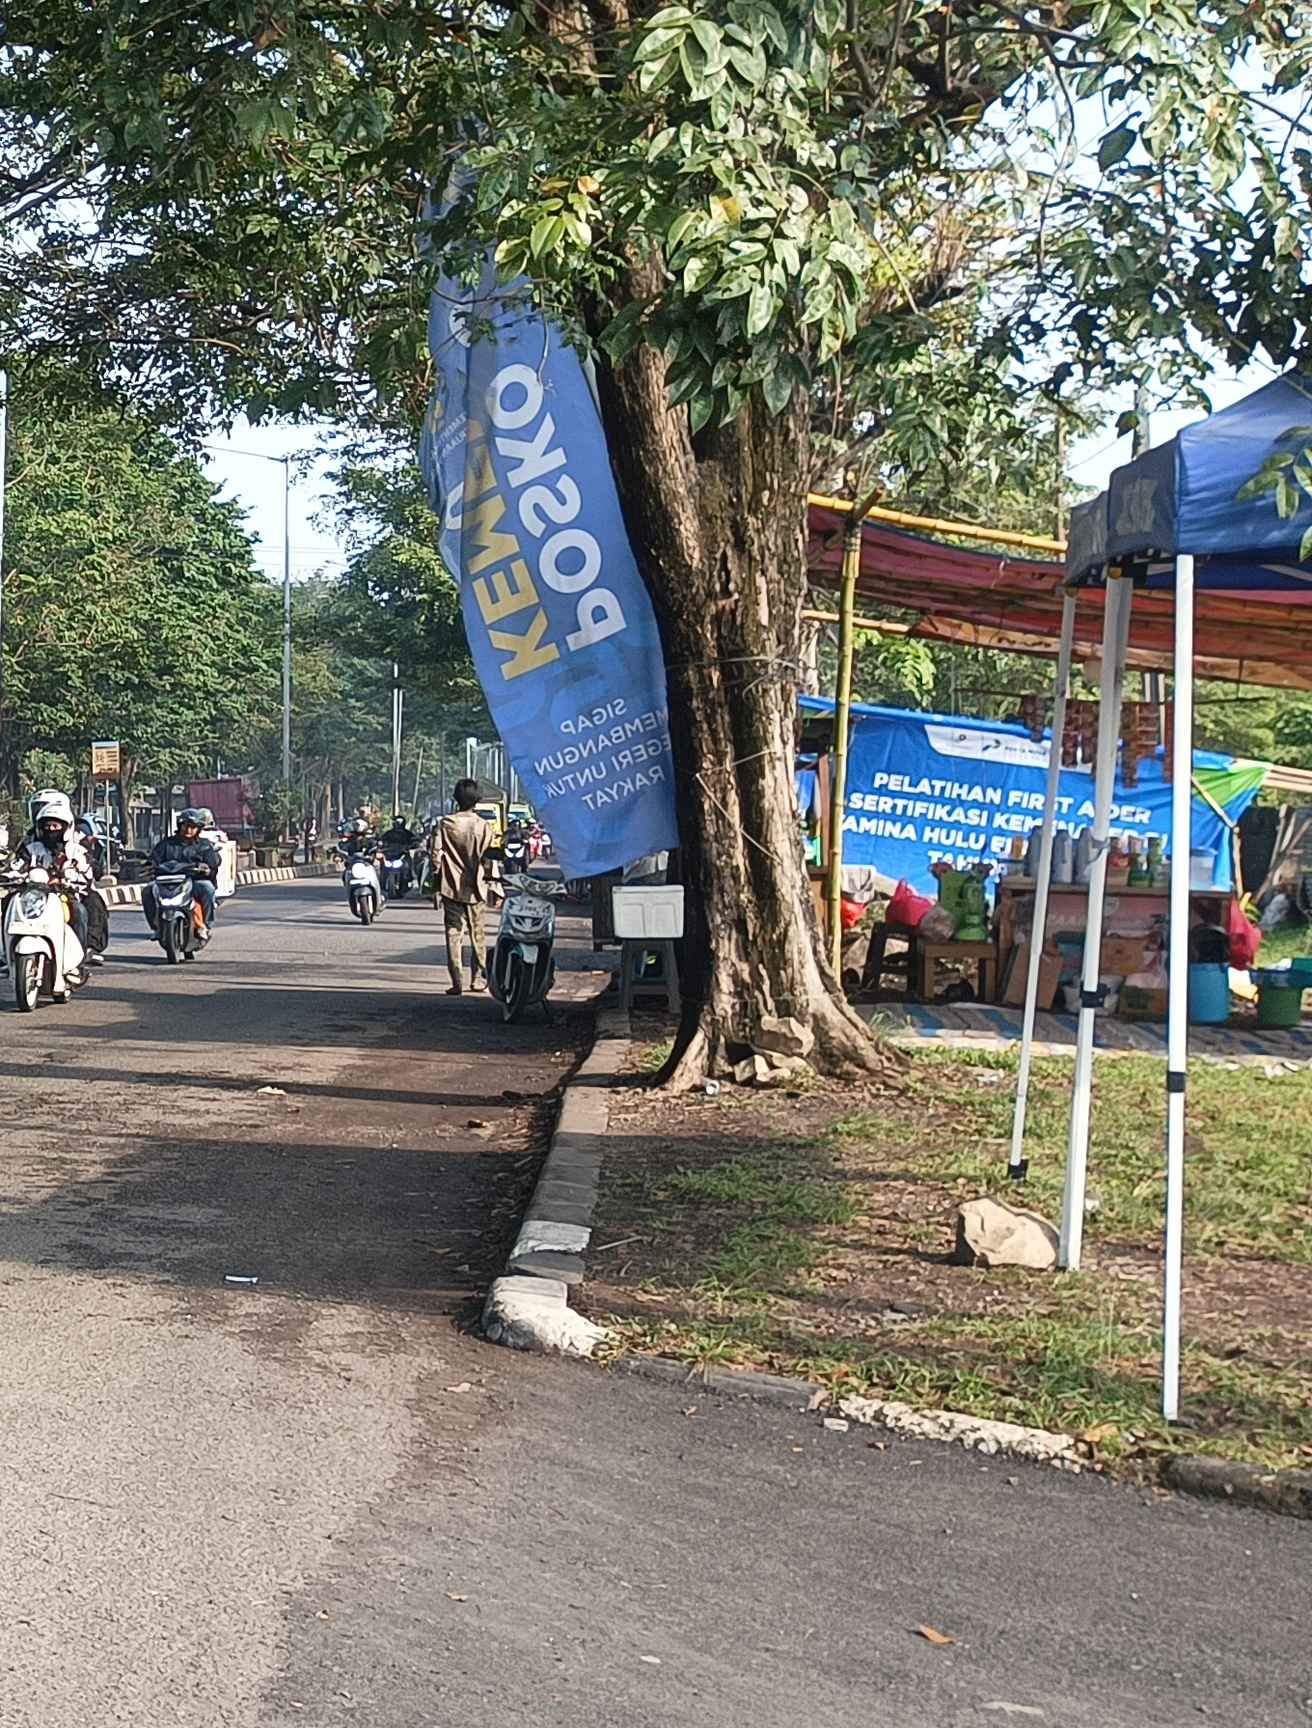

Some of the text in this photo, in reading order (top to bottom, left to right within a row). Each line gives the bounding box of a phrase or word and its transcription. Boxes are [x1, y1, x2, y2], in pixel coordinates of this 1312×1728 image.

[849, 793, 988, 827] SERTIFIKASI
[874, 772, 1152, 824] PELATIHAN FIRT ADER
[923, 826, 986, 850] HULU
